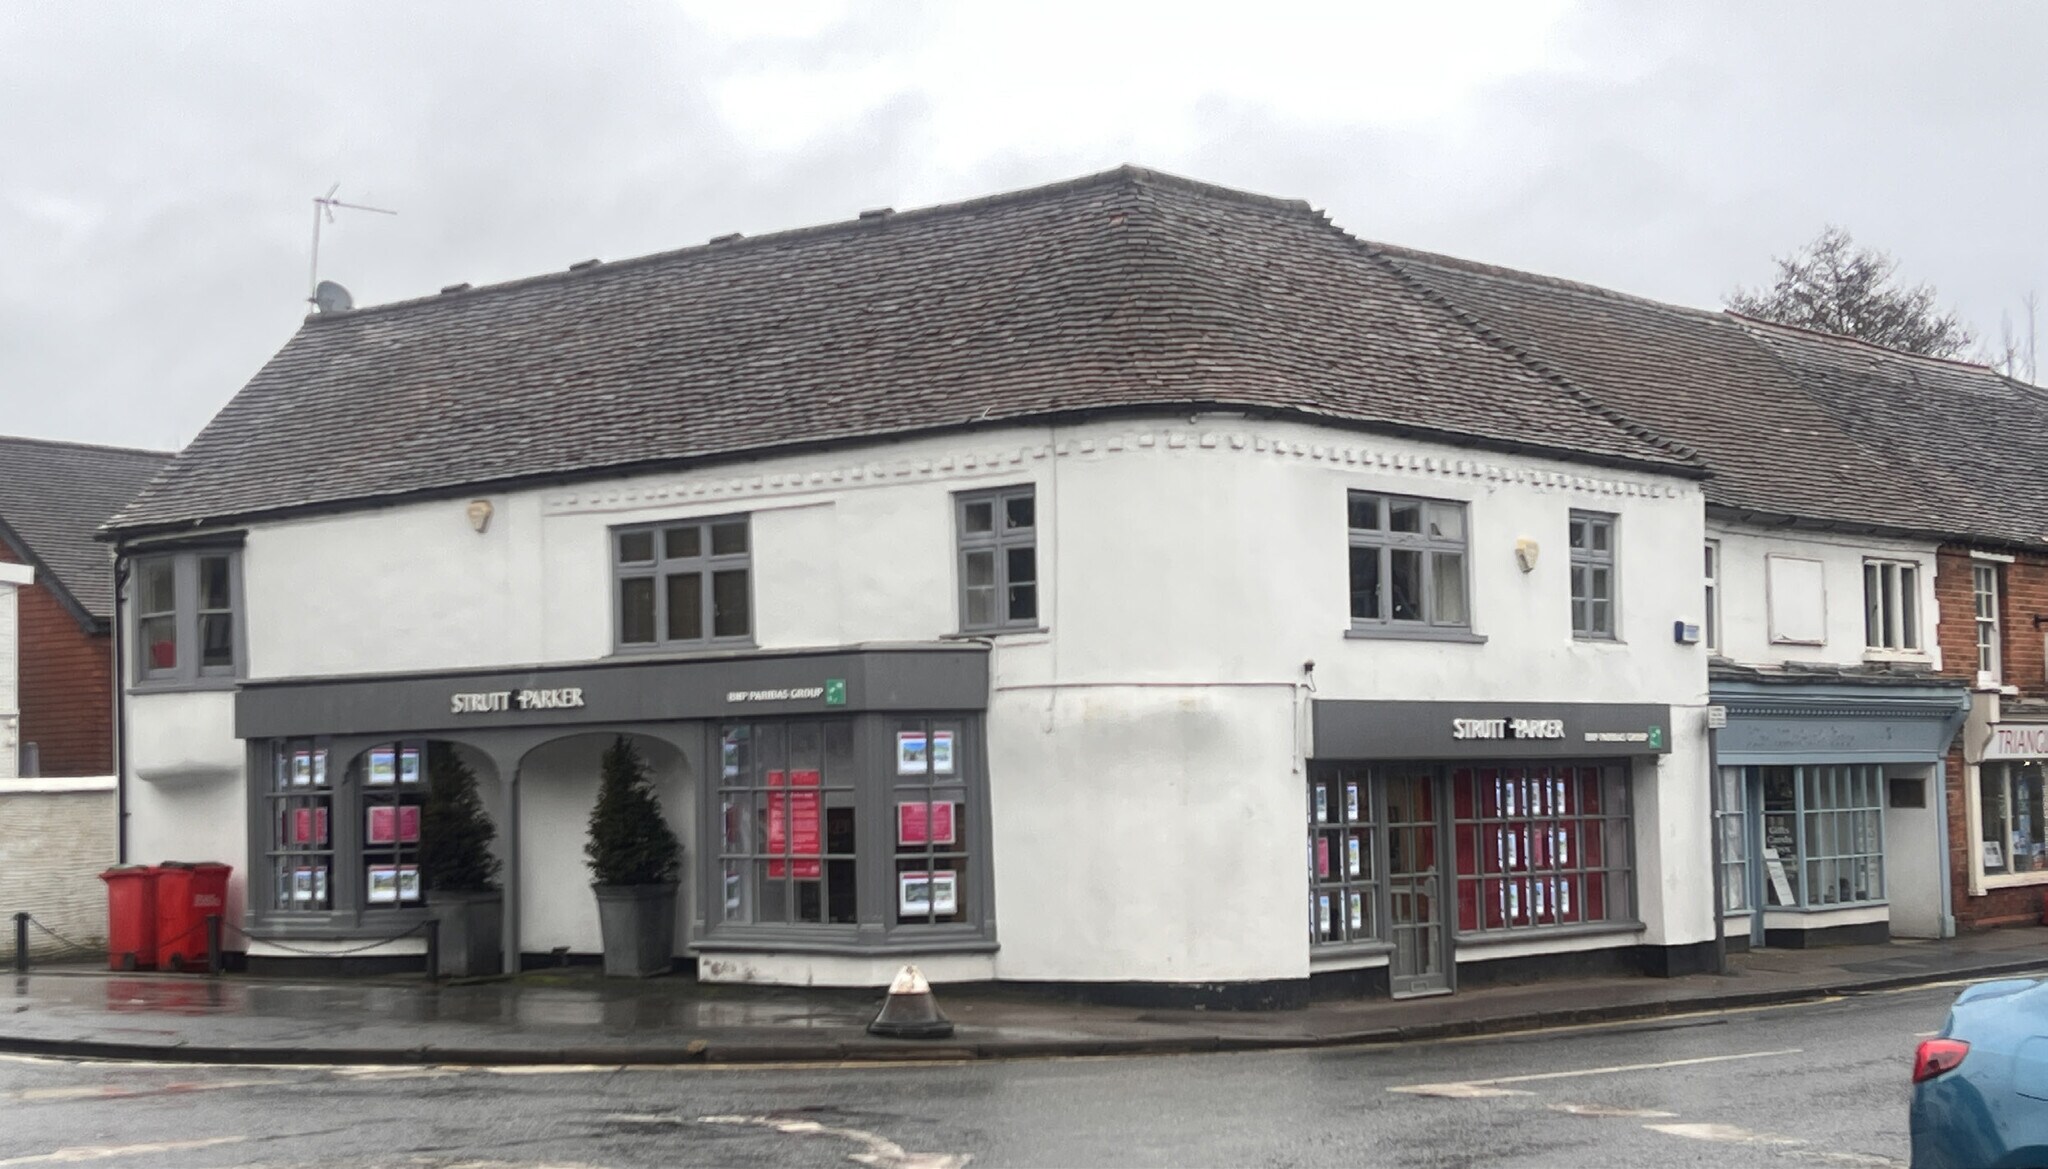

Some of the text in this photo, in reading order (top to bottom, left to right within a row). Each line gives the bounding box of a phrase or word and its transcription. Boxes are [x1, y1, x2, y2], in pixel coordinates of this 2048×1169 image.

[451, 691, 511, 713] STRUTT
[519, 687, 585, 709] PARKER
[790, 687, 824, 699] GROUP
[1453, 718, 1506, 739] STRUTT
[1514, 719, 1566, 738] PARKER
